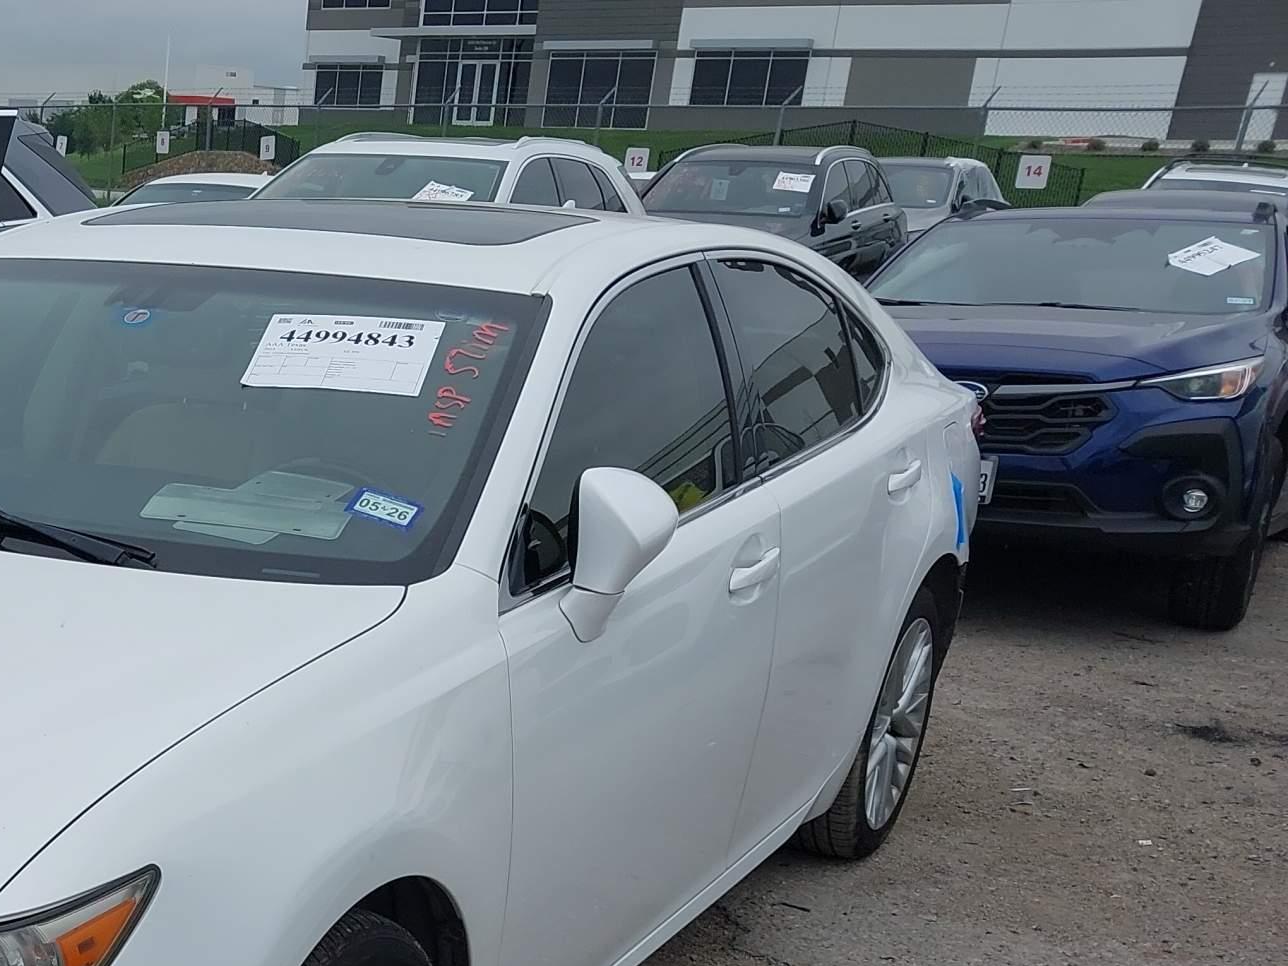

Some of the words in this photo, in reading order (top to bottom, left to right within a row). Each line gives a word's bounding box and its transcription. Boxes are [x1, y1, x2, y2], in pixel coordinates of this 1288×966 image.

[630, 156, 643, 167] 12
[1025, 165, 1043, 177] 14
[280, 329, 416, 349] 44994843
